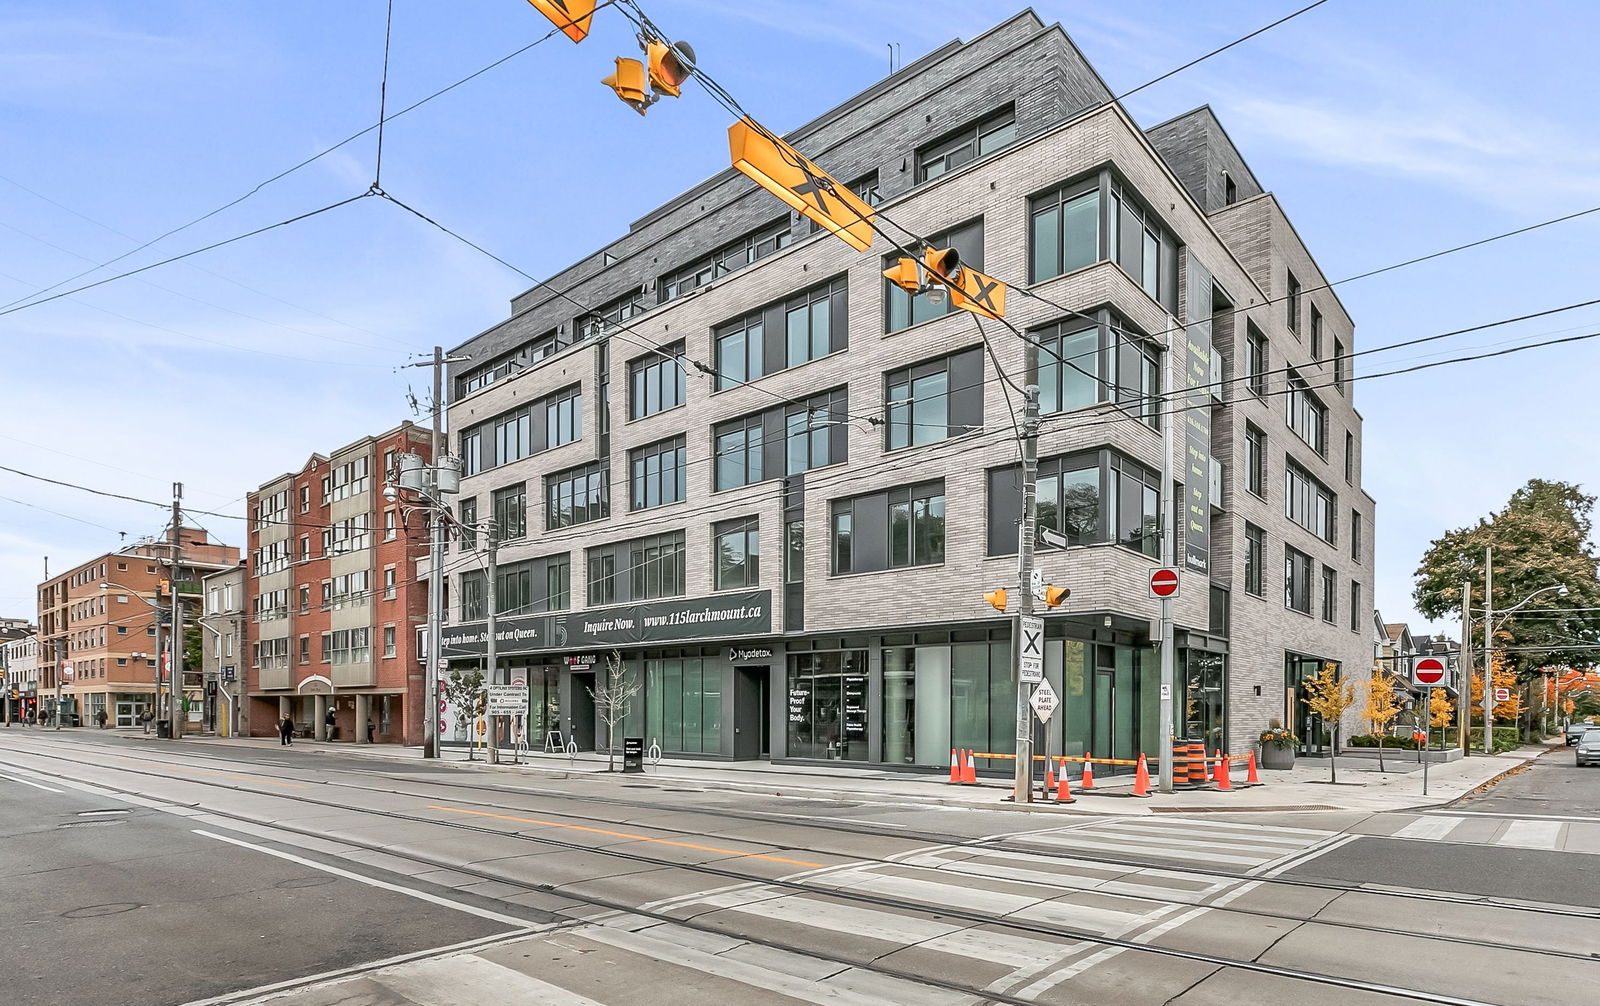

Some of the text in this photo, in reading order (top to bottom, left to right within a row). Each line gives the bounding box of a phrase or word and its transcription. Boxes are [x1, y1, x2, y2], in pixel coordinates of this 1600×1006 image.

[584, 605, 761, 635] Inquire Now. www.115larchmount.ca
[441, 628, 538, 648] tep into home. Ste ut on Queen.
[1023, 629, 1041, 655] X
[789, 714, 805, 722] Body.
